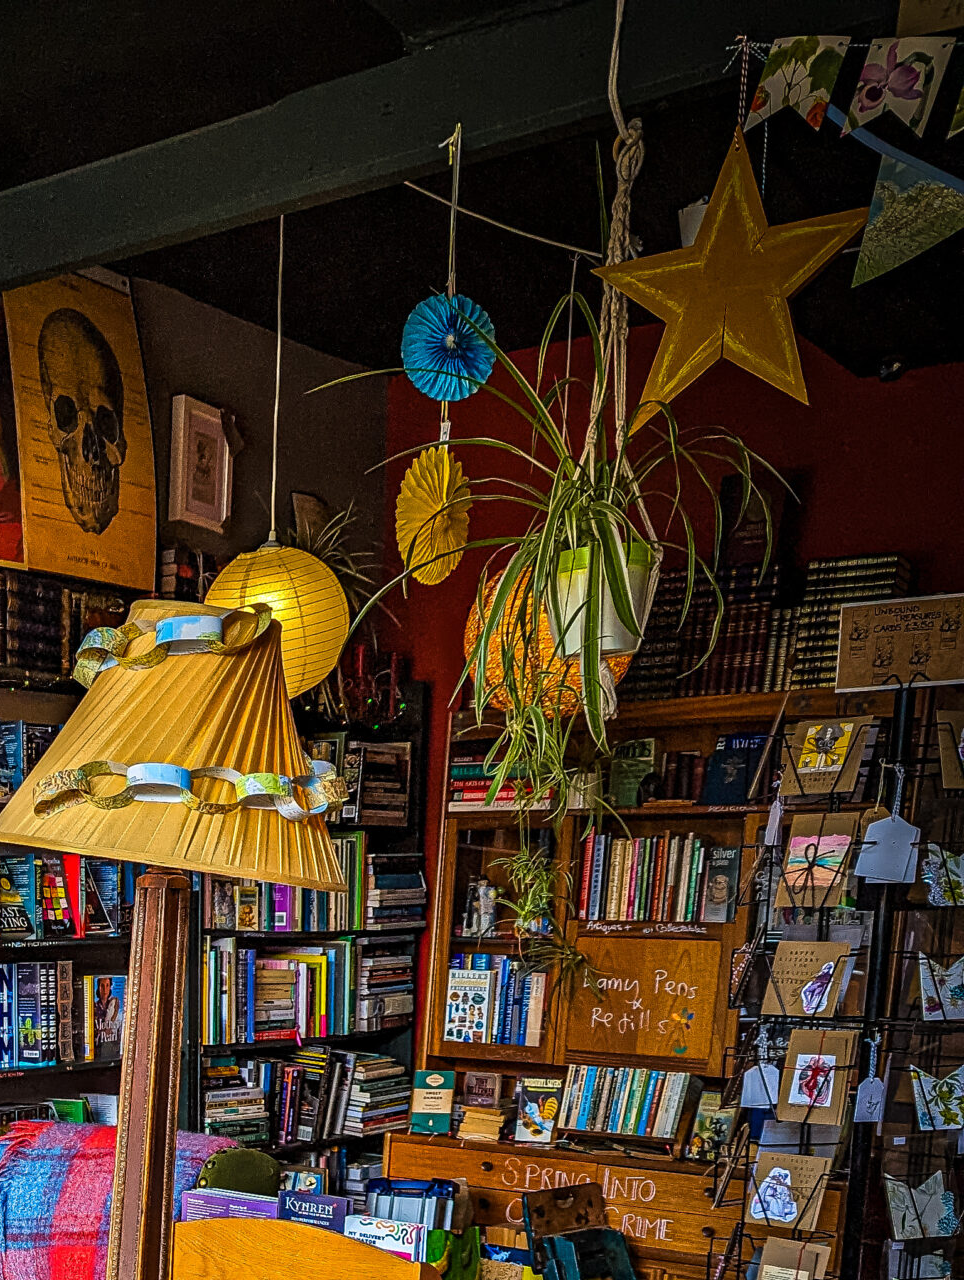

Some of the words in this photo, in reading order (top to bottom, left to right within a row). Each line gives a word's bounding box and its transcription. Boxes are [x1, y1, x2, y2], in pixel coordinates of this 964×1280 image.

[874, 606, 920, 617] UNBOUND
[893, 611, 942, 622] TREASURES
[873, 624, 902, 633] CARDS
[712, 849, 736, 859] silver
[583, 973, 638, 999] Lamy
[654, 969, 699, 999] Pens
[59, 966, 72, 1058] BABEL
[501, 1157, 591, 1192] SPRING
[601, 1167, 656, 1202] INTO
[285, 1196, 333, 1215] KYNREN
[359, 1233, 386, 1241] DELIVERY
